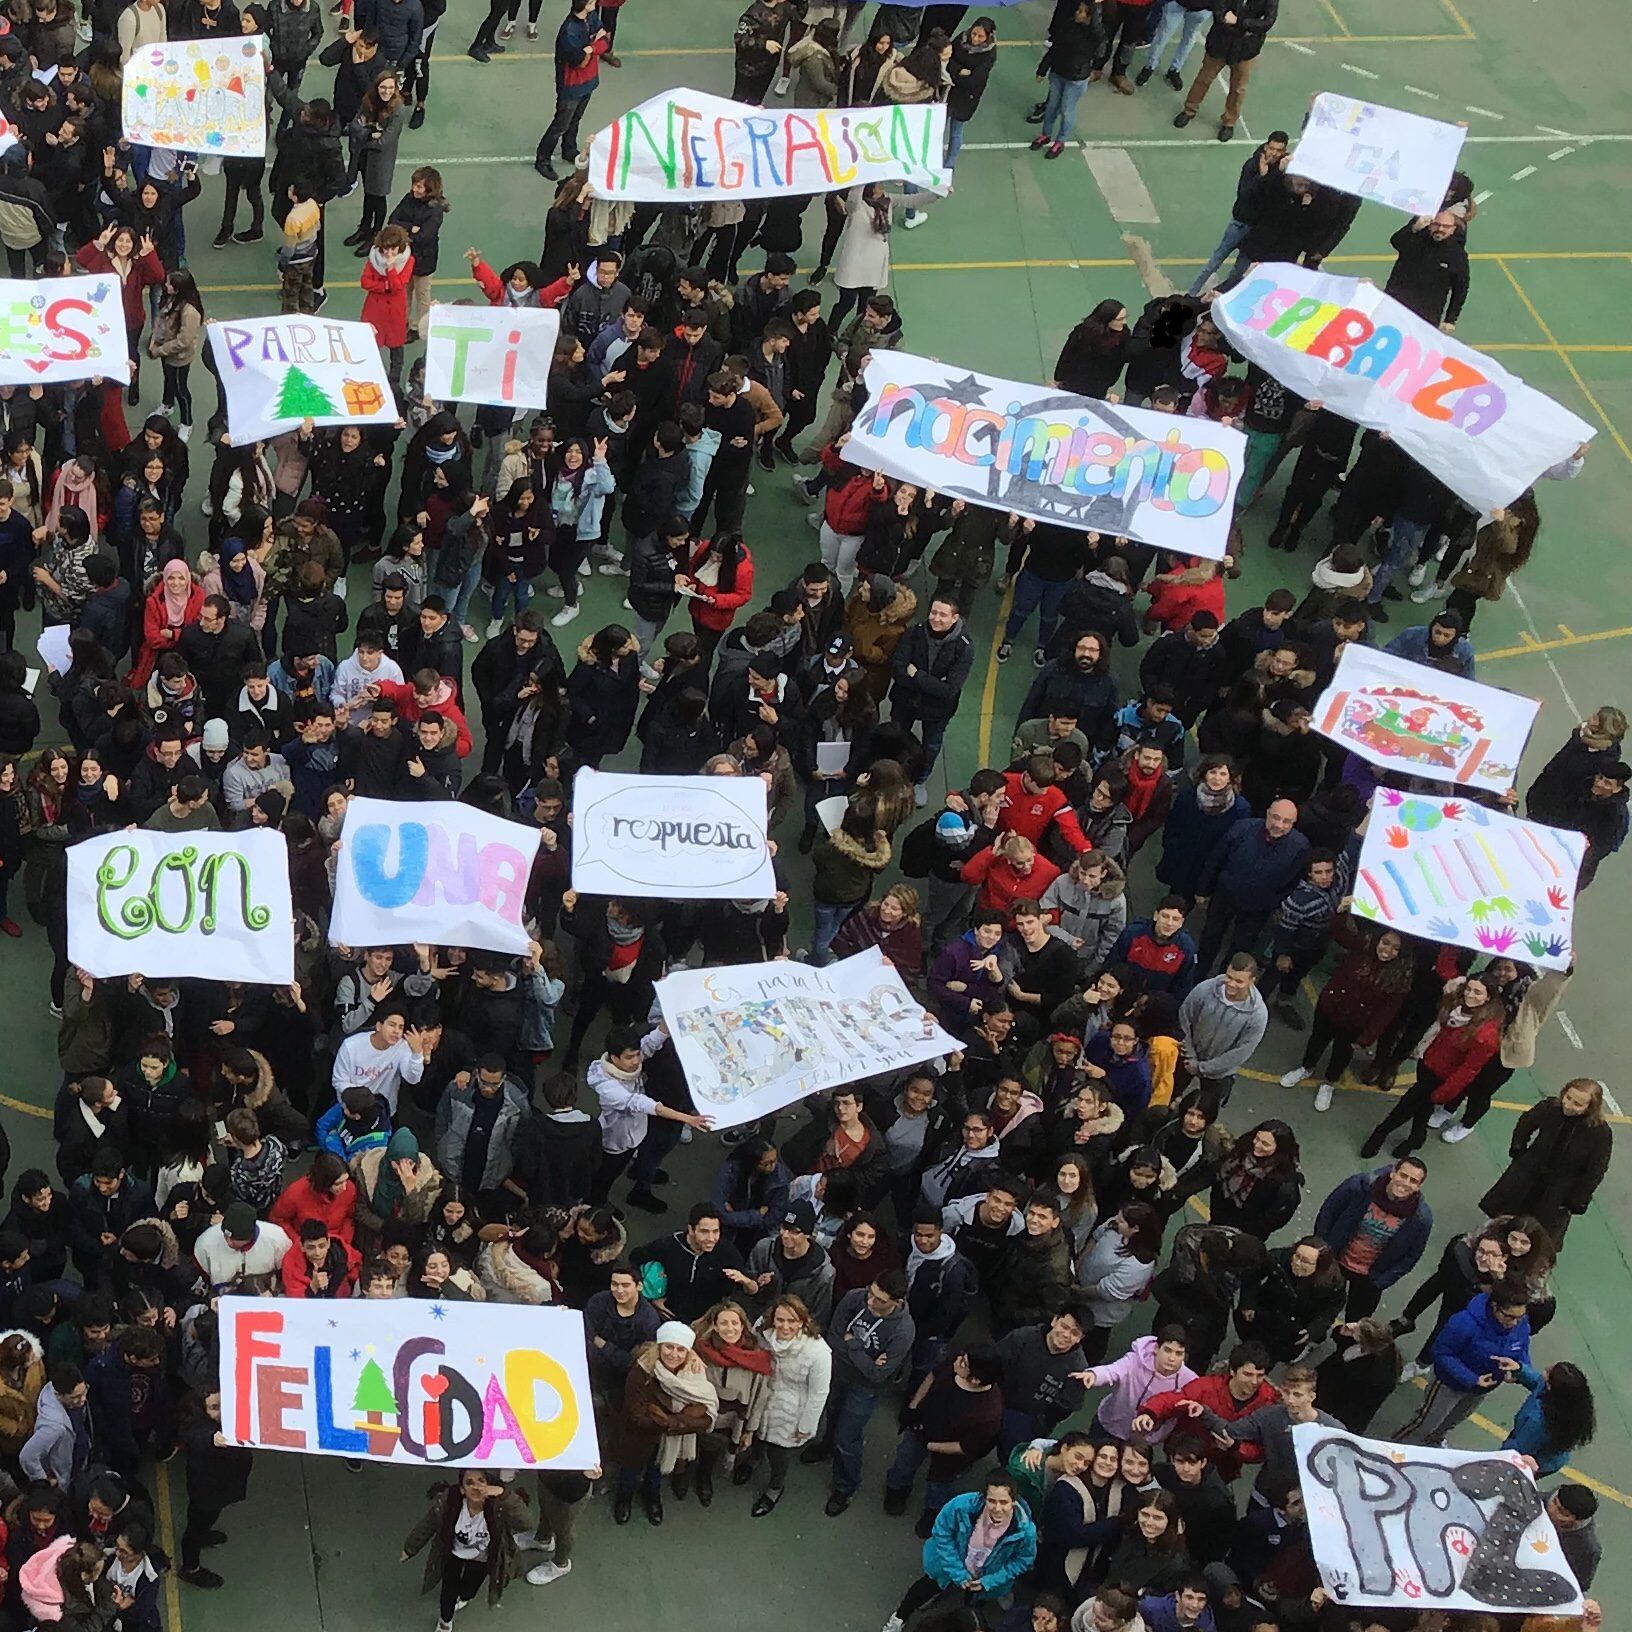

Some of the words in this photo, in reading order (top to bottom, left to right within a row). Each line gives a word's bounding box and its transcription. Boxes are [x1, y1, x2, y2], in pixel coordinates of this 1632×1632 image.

[223, 324, 366, 372] PARA
[872, 383, 1230, 517] nacimiento
[351, 822, 527, 925] UNA
[613, 816, 757, 851] respuesta
[1307, 1437, 1578, 1608] PAZ
